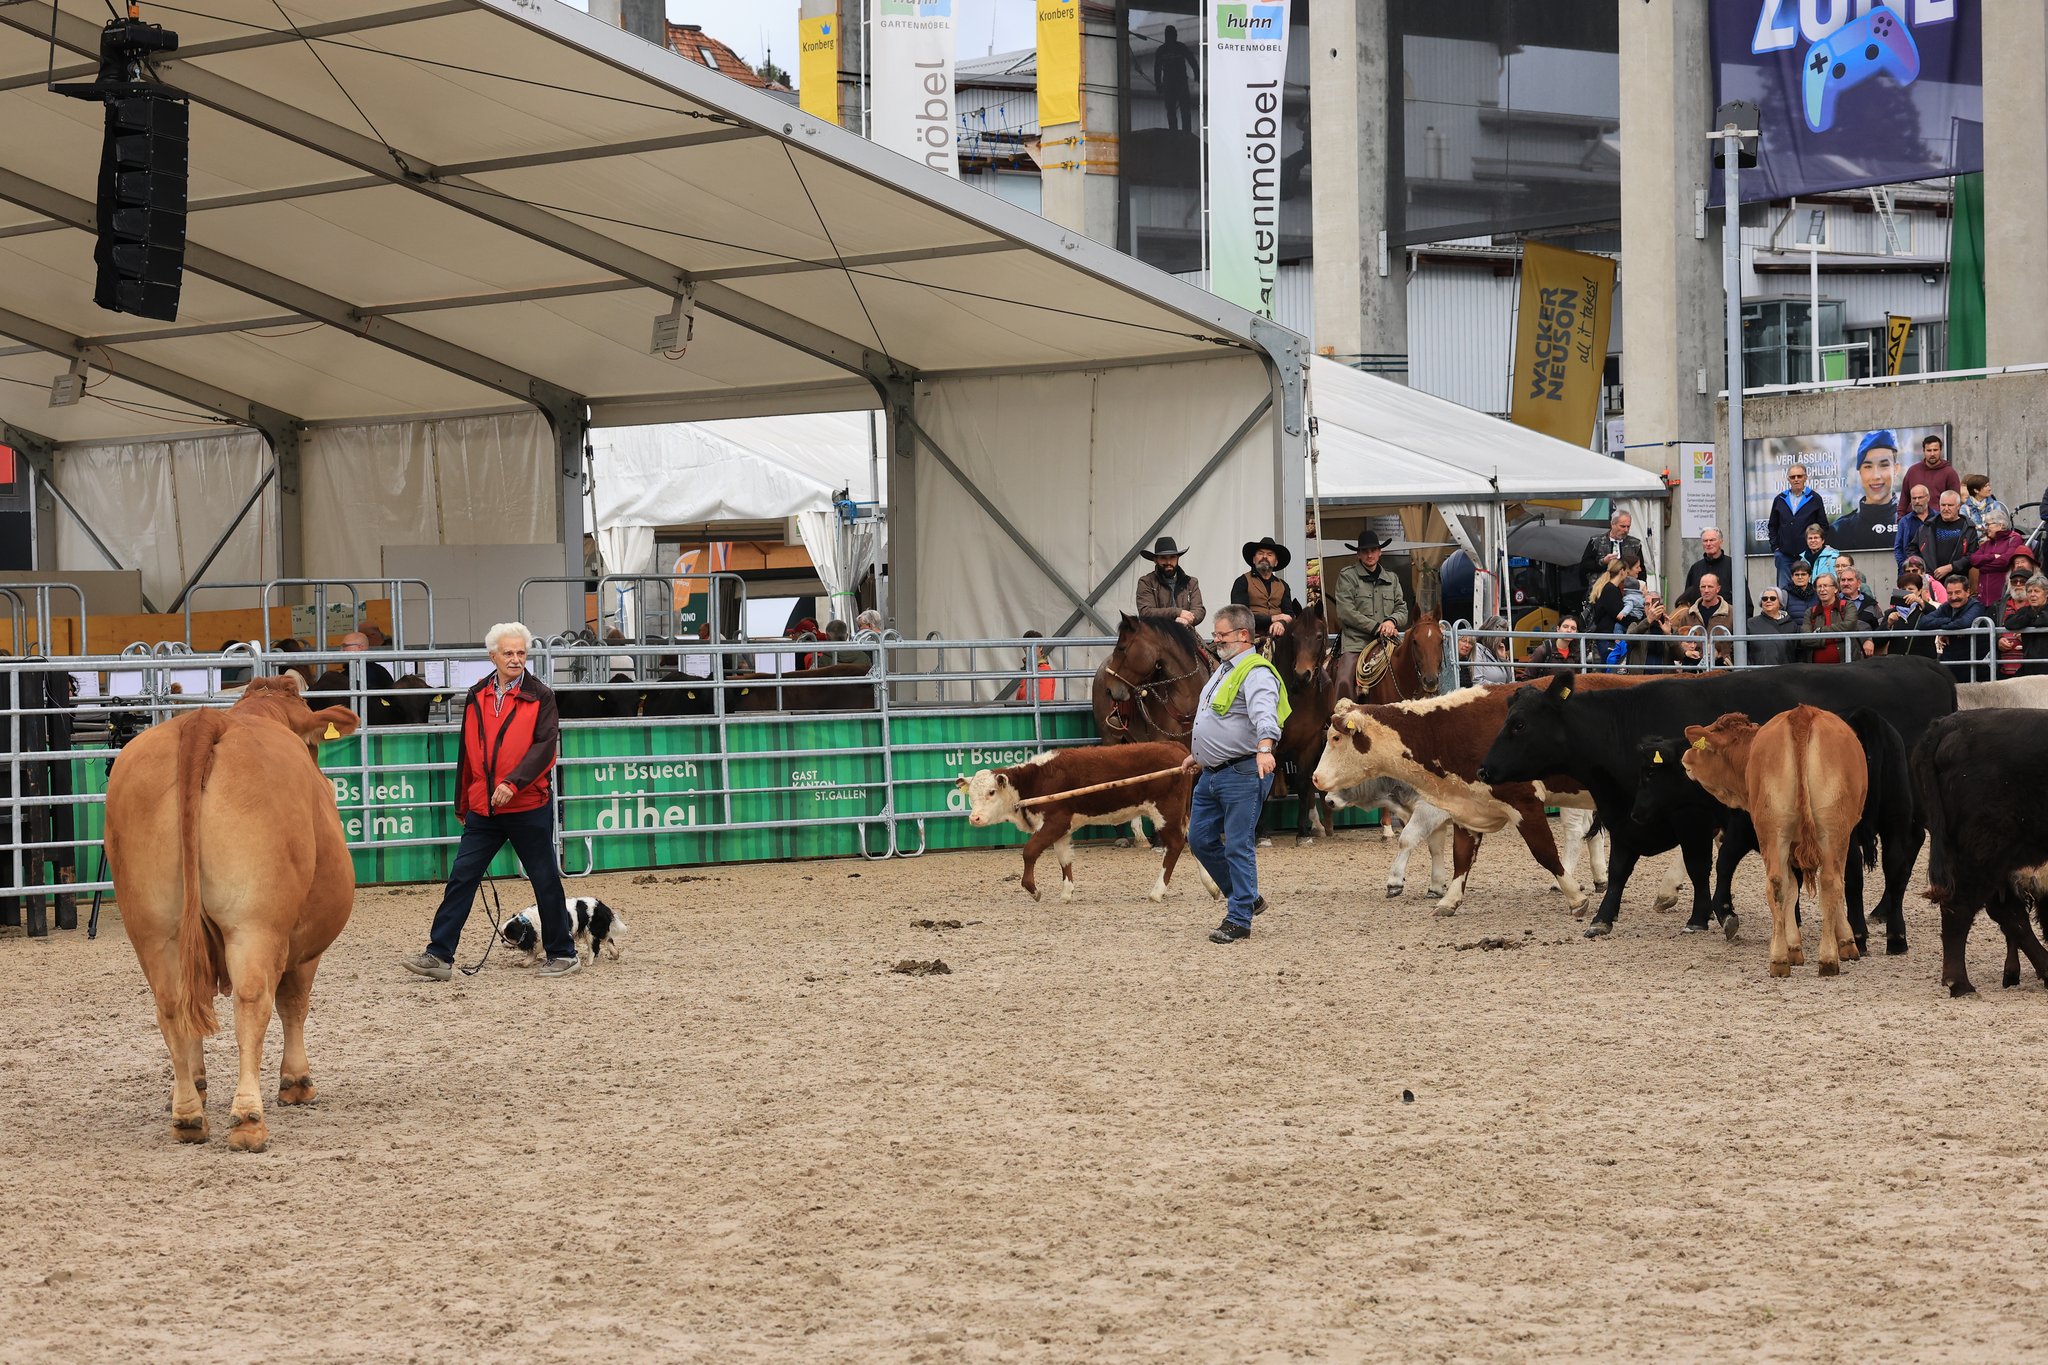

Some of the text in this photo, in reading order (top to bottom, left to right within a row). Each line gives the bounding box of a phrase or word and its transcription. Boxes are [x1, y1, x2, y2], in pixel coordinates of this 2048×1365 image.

[1039, 8, 1074, 21] Kronberg
[1227, 13, 1272, 29] hunn
[880, 20, 950, 30] GARTENMÖBEL
[802, 39, 834, 52] Kronberg
[1217, 42, 1282, 52] GARTENMÖBEL
[1576, 276, 1598, 364] all it takes!
[1530, 287, 1559, 399] WACKER
[1546, 288, 1578, 400] NEUSON
[1776, 452, 1837, 466] VERLÄSSLICH,
[623, 760, 698, 781] Bsuech
[792, 770, 818, 781] GAST
[814, 789, 867, 801] ST.GALLEN
[596, 788, 697, 831] dihei
